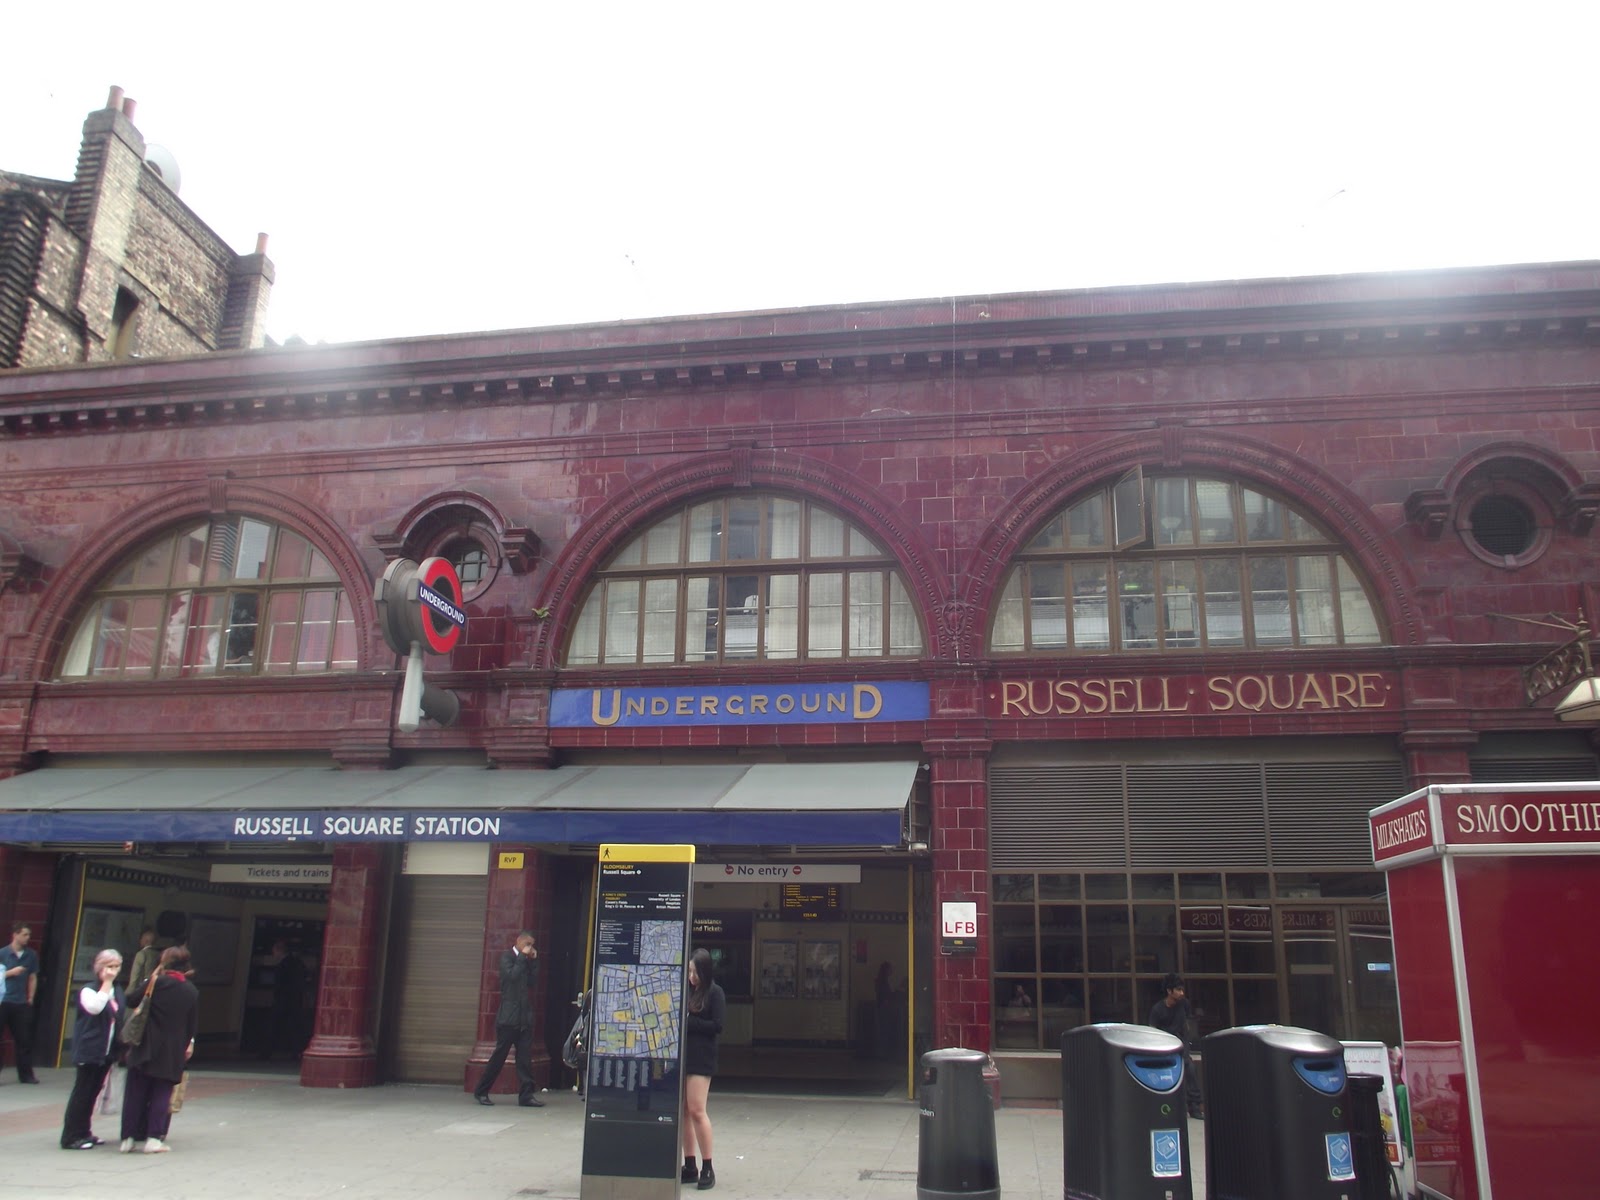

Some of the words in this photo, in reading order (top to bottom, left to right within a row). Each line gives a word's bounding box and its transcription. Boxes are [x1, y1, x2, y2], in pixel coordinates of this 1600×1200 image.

[420, 586, 465, 624] UNDERGROUND
[1001, 677, 1189, 717] RUSSELL
[1207, 673, 1387, 712] SQUARE
[234, 816, 313, 836] RUSSELL
[323, 816, 404, 836] SQUARE
[414, 816, 501, 836] STATION
[1375, 809, 1427, 850] MILKSHAKES
[247, 867, 280, 878] Tickets
[283, 867, 300, 878] and
[303, 867, 330, 878] trains
[737, 865, 754, 876] No
[758, 866, 789, 878] entry
[944, 921, 975, 934] LFB
